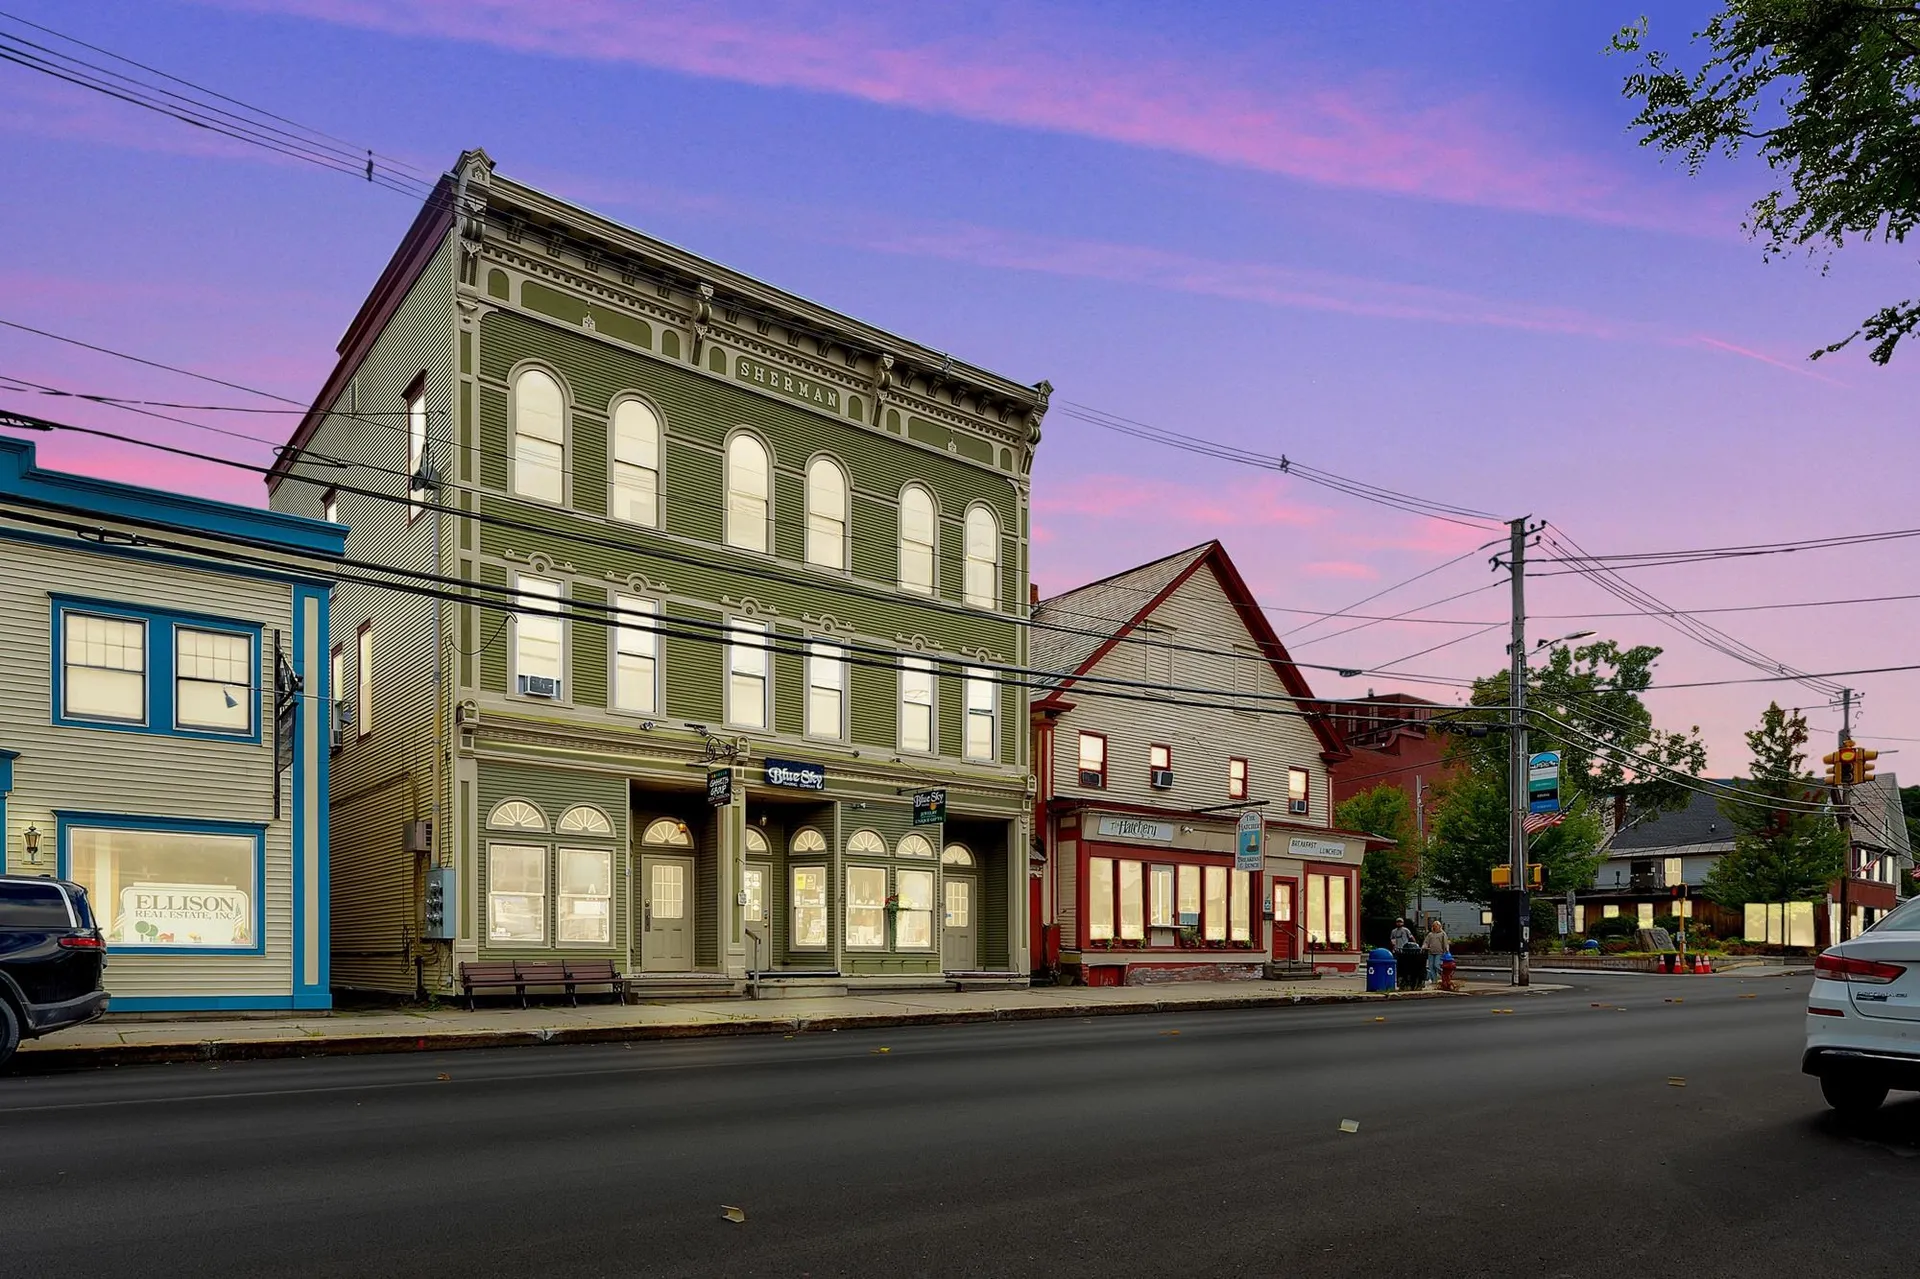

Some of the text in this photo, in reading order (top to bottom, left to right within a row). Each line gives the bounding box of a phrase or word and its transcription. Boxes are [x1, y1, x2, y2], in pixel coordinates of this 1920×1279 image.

[740, 362, 837, 408] SHERMAN
[768, 767, 823, 789] Blue Sky
[1118, 820, 1158, 838] Hatchery
[135, 894, 235, 911] ELLISON
